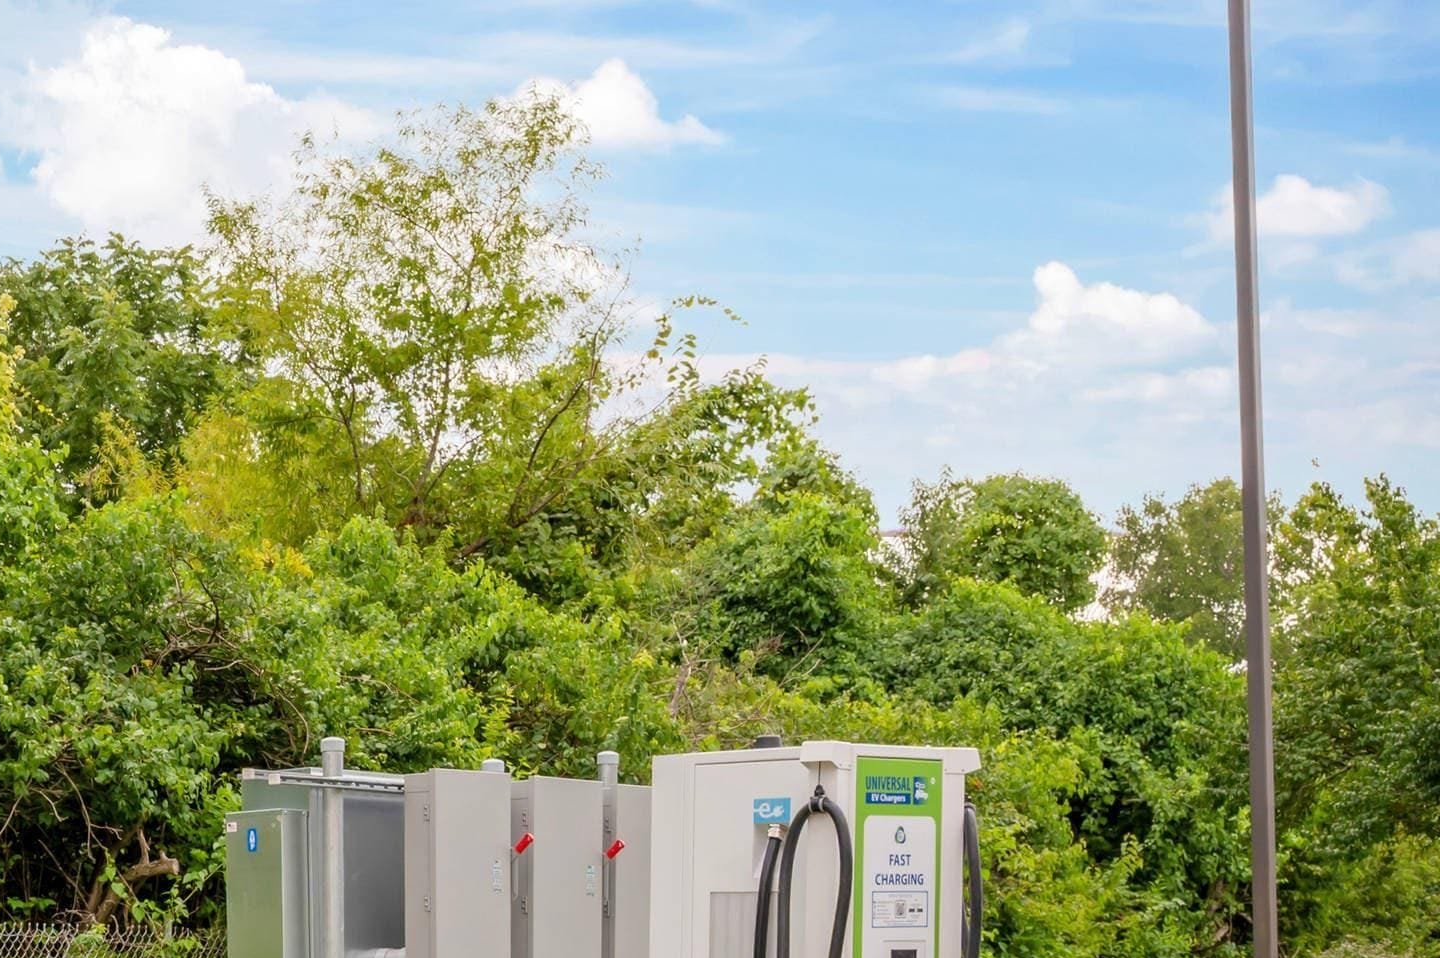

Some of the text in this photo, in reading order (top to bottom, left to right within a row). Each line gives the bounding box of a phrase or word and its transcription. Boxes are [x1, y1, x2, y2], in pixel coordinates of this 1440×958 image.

[866, 777, 911, 791] UNIVERSAL
[871, 793, 906, 804] EV Chargers
[889, 854, 911, 866] FAST
[875, 873, 924, 886] CHARGING
